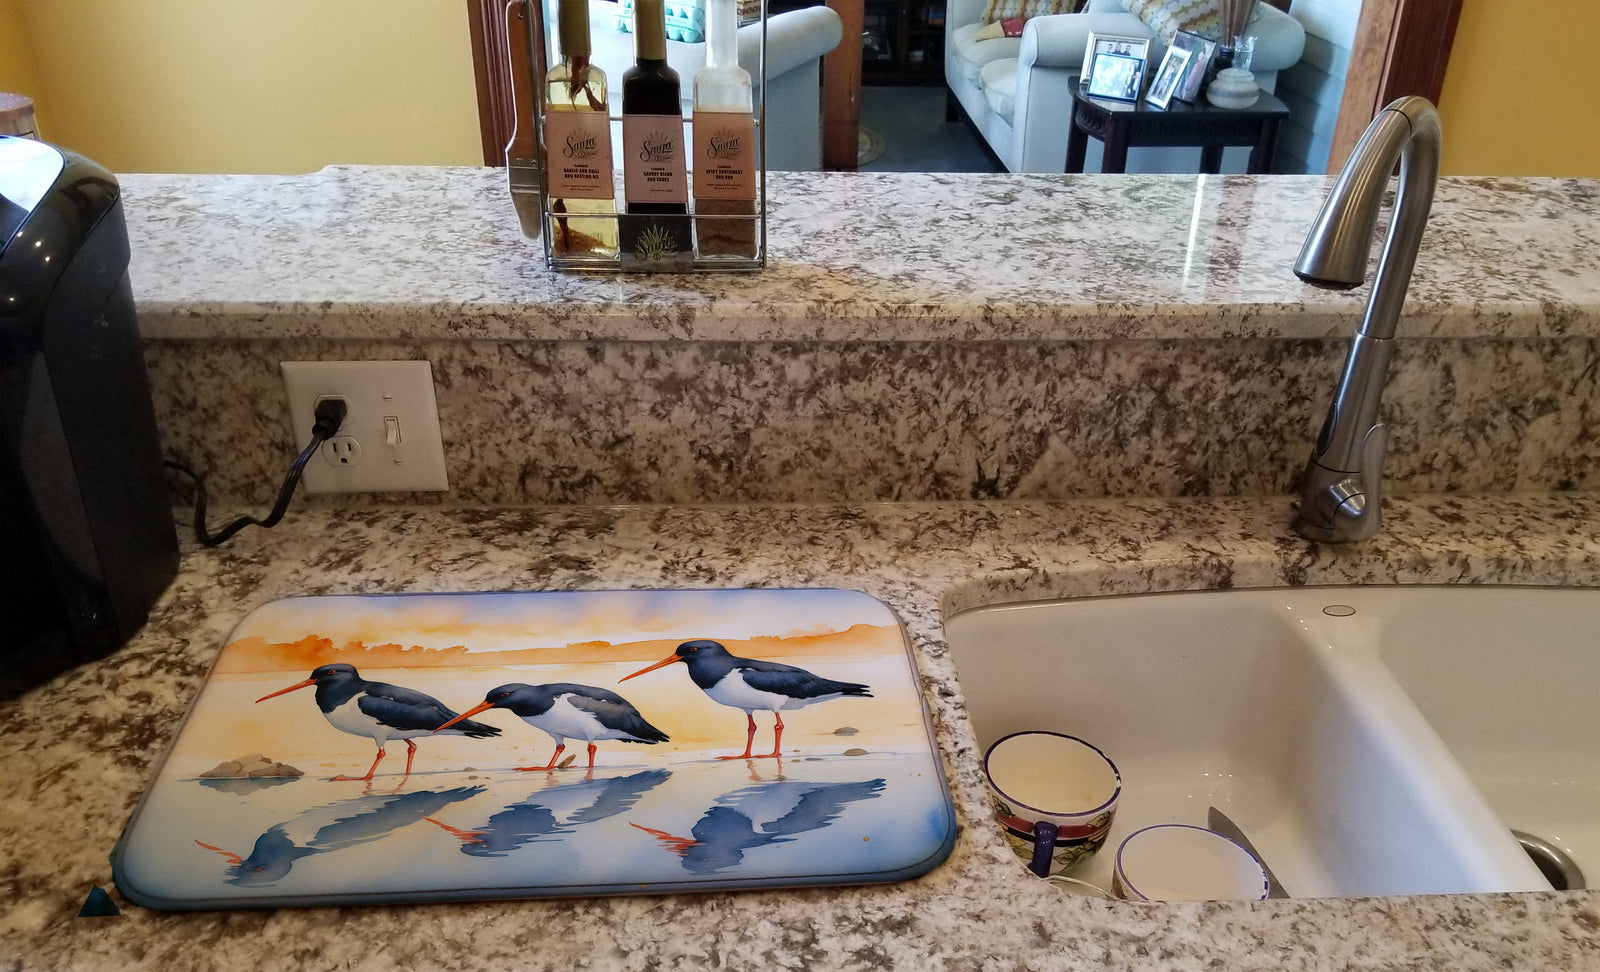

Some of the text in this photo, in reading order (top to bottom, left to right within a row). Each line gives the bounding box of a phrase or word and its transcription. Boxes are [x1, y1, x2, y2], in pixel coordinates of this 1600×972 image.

[563, 136, 597, 158] Sauza
[640, 140, 674, 162] Sauza
[707, 136, 740, 159] Sauza
